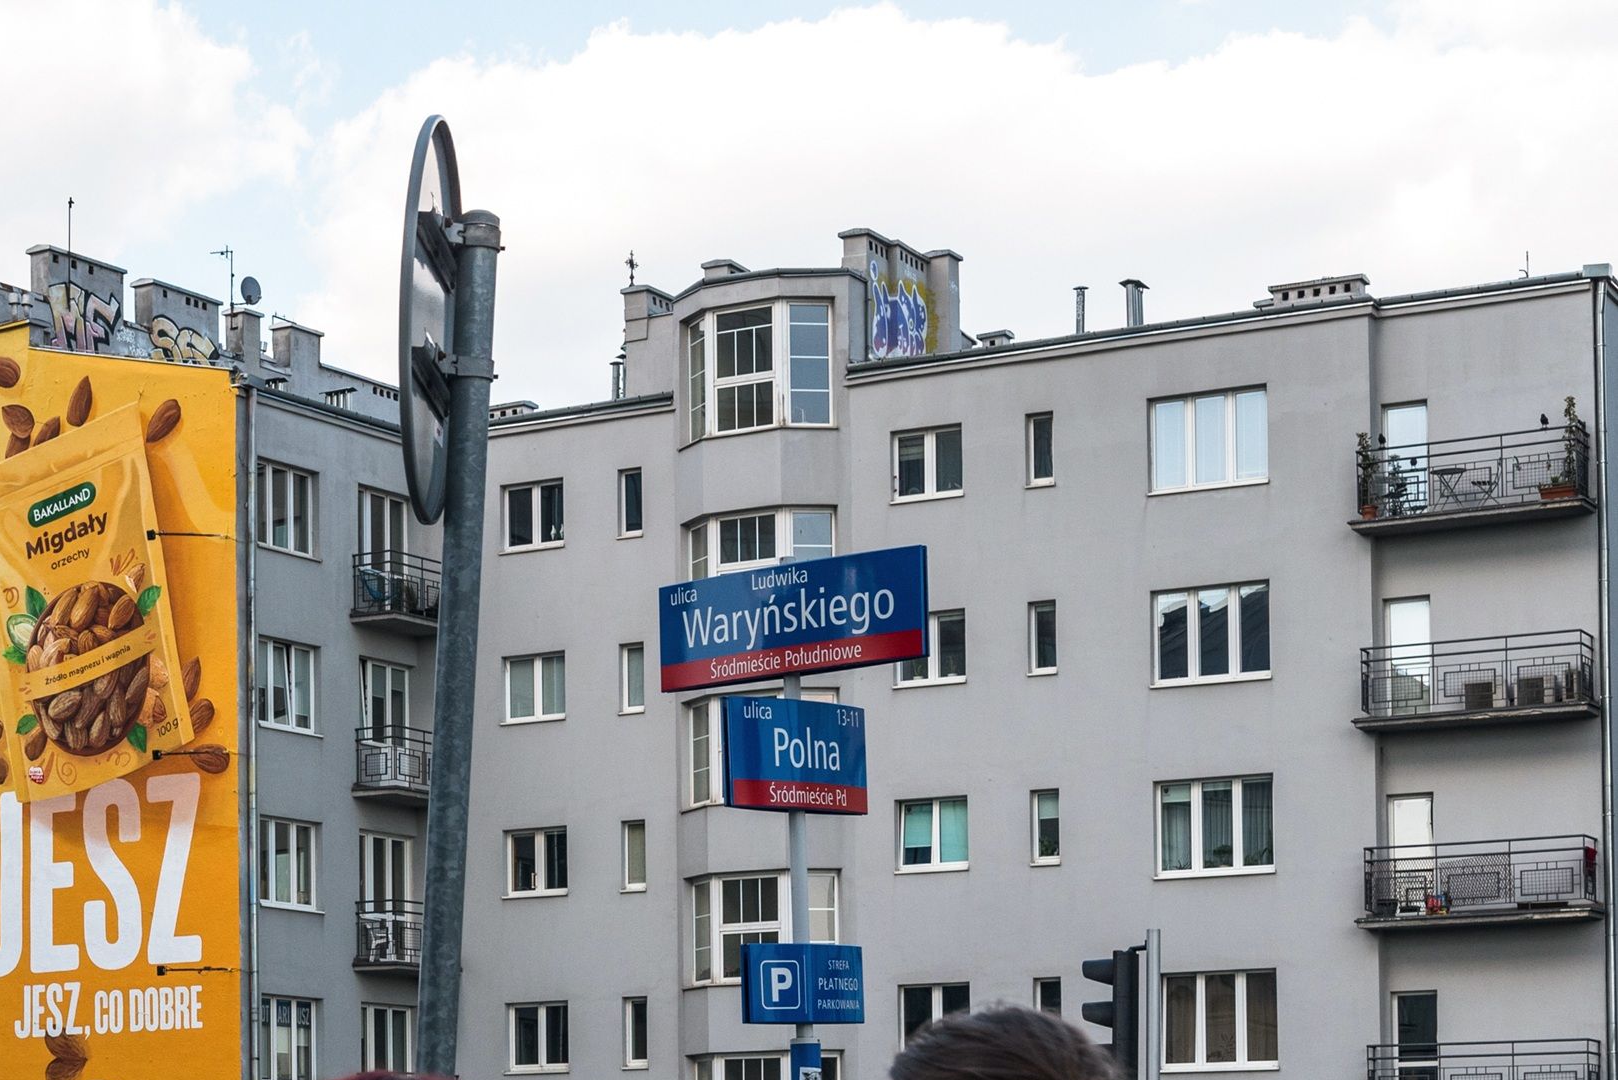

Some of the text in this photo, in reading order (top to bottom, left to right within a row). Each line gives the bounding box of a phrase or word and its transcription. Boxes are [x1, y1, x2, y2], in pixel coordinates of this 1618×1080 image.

[33, 487, 91, 522] BAKALLAND
[25, 512, 108, 560] Migdały
[50, 548, 90, 571] orzechy
[751, 566, 808, 591] Ludwika
[670, 586, 698, 606] ulica
[682, 586, 895, 650] Waryńskiego
[68, 660, 101, 679] magnezu
[105, 644, 131, 661] wapnia
[710, 643, 862, 679] Śródmieście Południowe
[157, 718, 179, 738] 100 g
[743, 700, 859, 728] ulica 13-11
[773, 727, 841, 772] Polna
[769, 781, 848, 806] Śródmieście Pd
[828, 959, 850, 970] STREFA
[771, 967, 793, 1002] P
[818, 977, 858, 991] PŁATNEGO
[14, 981, 203, 1041] JESZ, CO DOBRE
[817, 1000, 860, 1010] PARKOWANIA
